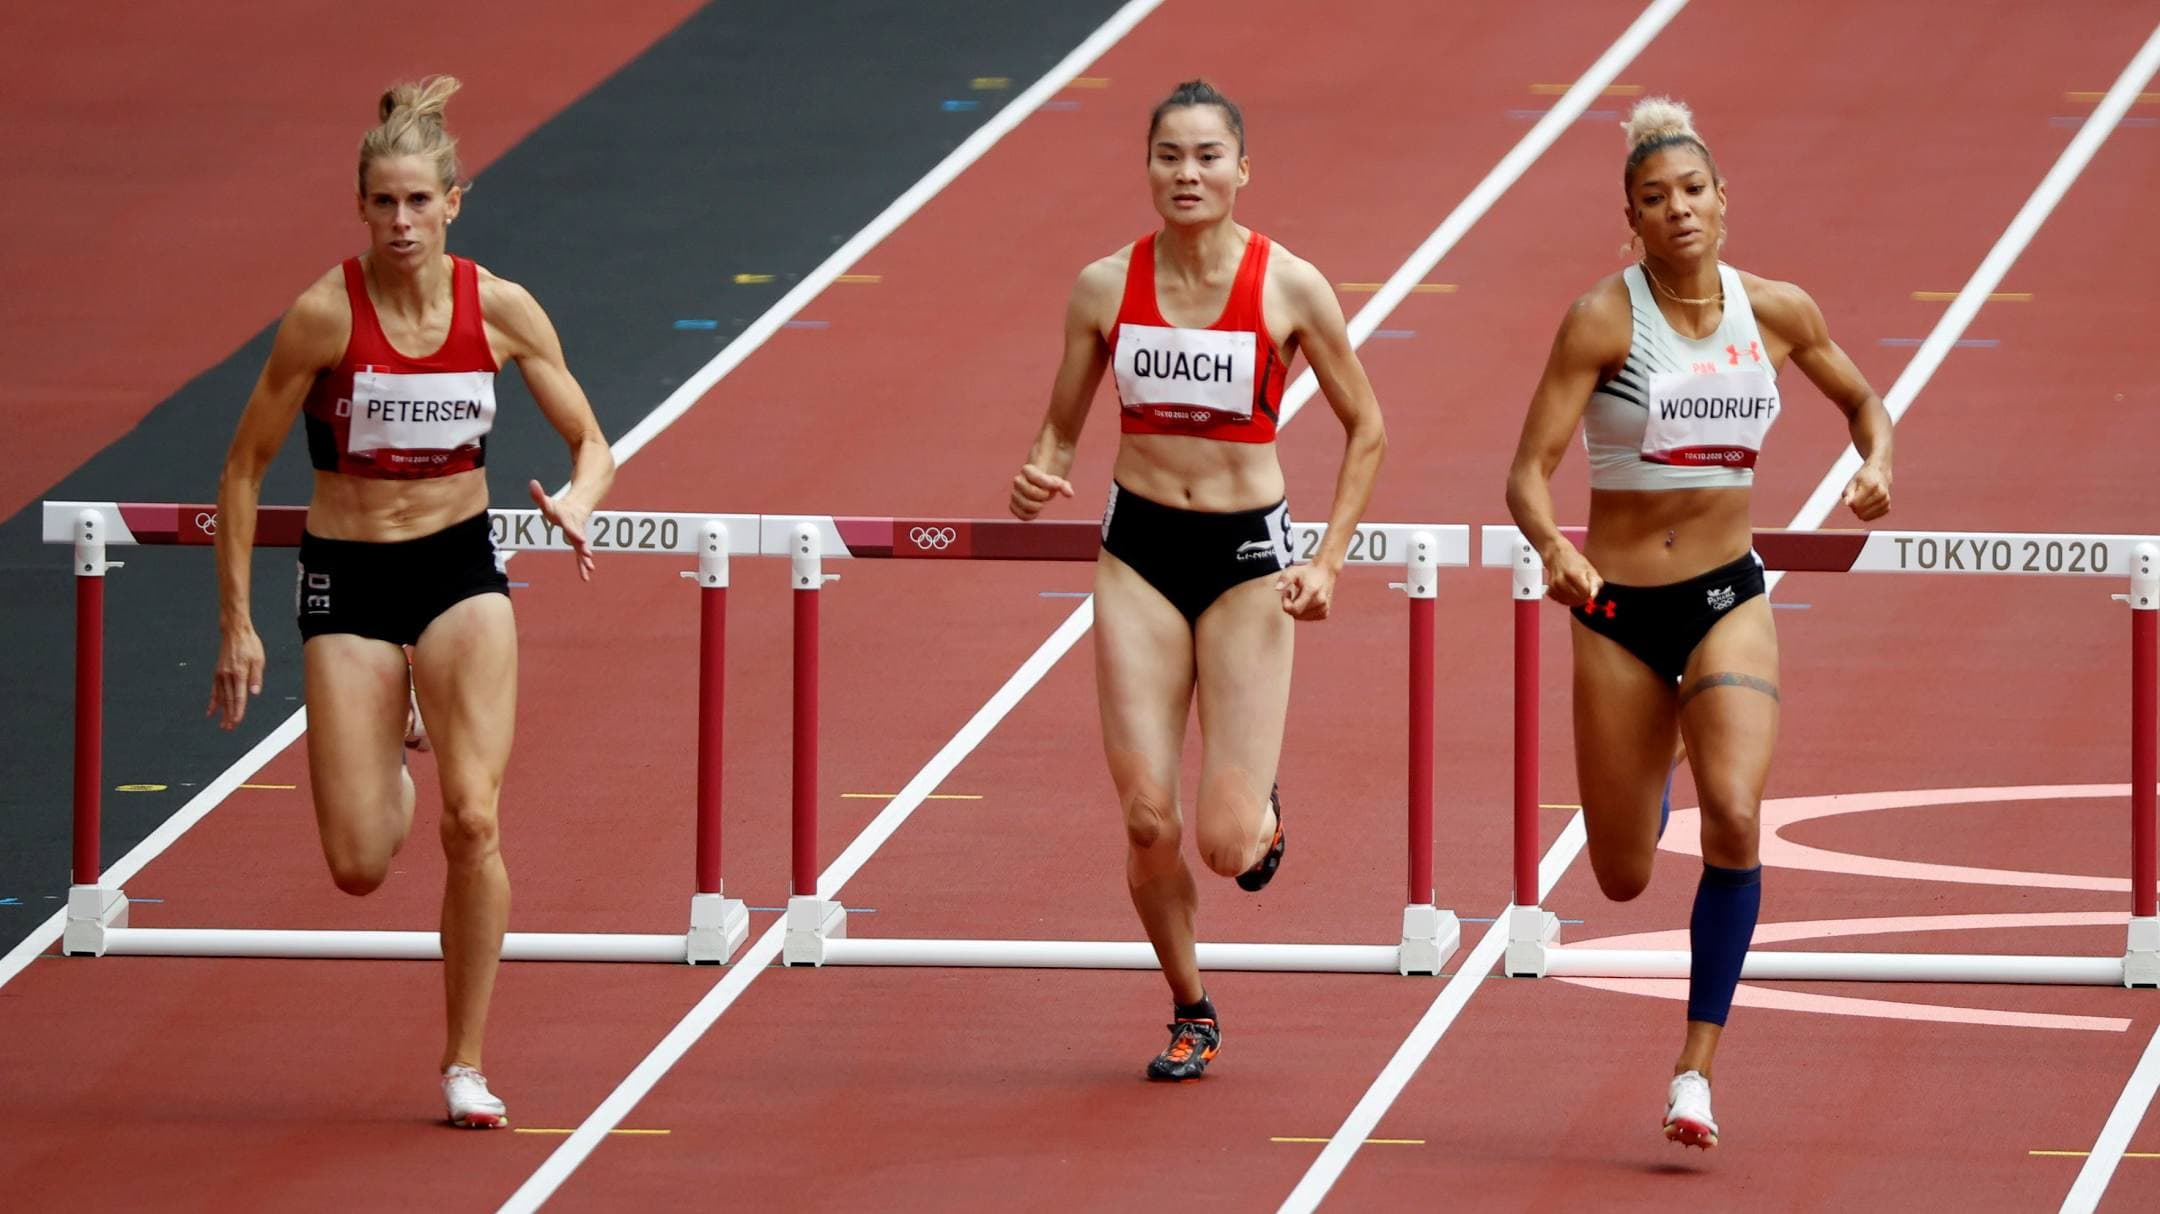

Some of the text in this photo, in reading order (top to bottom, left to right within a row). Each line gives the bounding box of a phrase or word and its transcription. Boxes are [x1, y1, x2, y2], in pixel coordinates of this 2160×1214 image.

[1134, 348, 1232, 382] QUACH
[367, 399, 481, 422] PETERSEN
[1153, 409, 1173, 418] TOKYO
[1660, 397, 1776, 420] WOODRUFF
[1685, 452, 1722, 460] TOKYO 2020
[488, 513, 679, 549] OKY 2020
[1302, 529, 1387, 562] 220
[1894, 538, 2109, 573] TOKYO 2020
